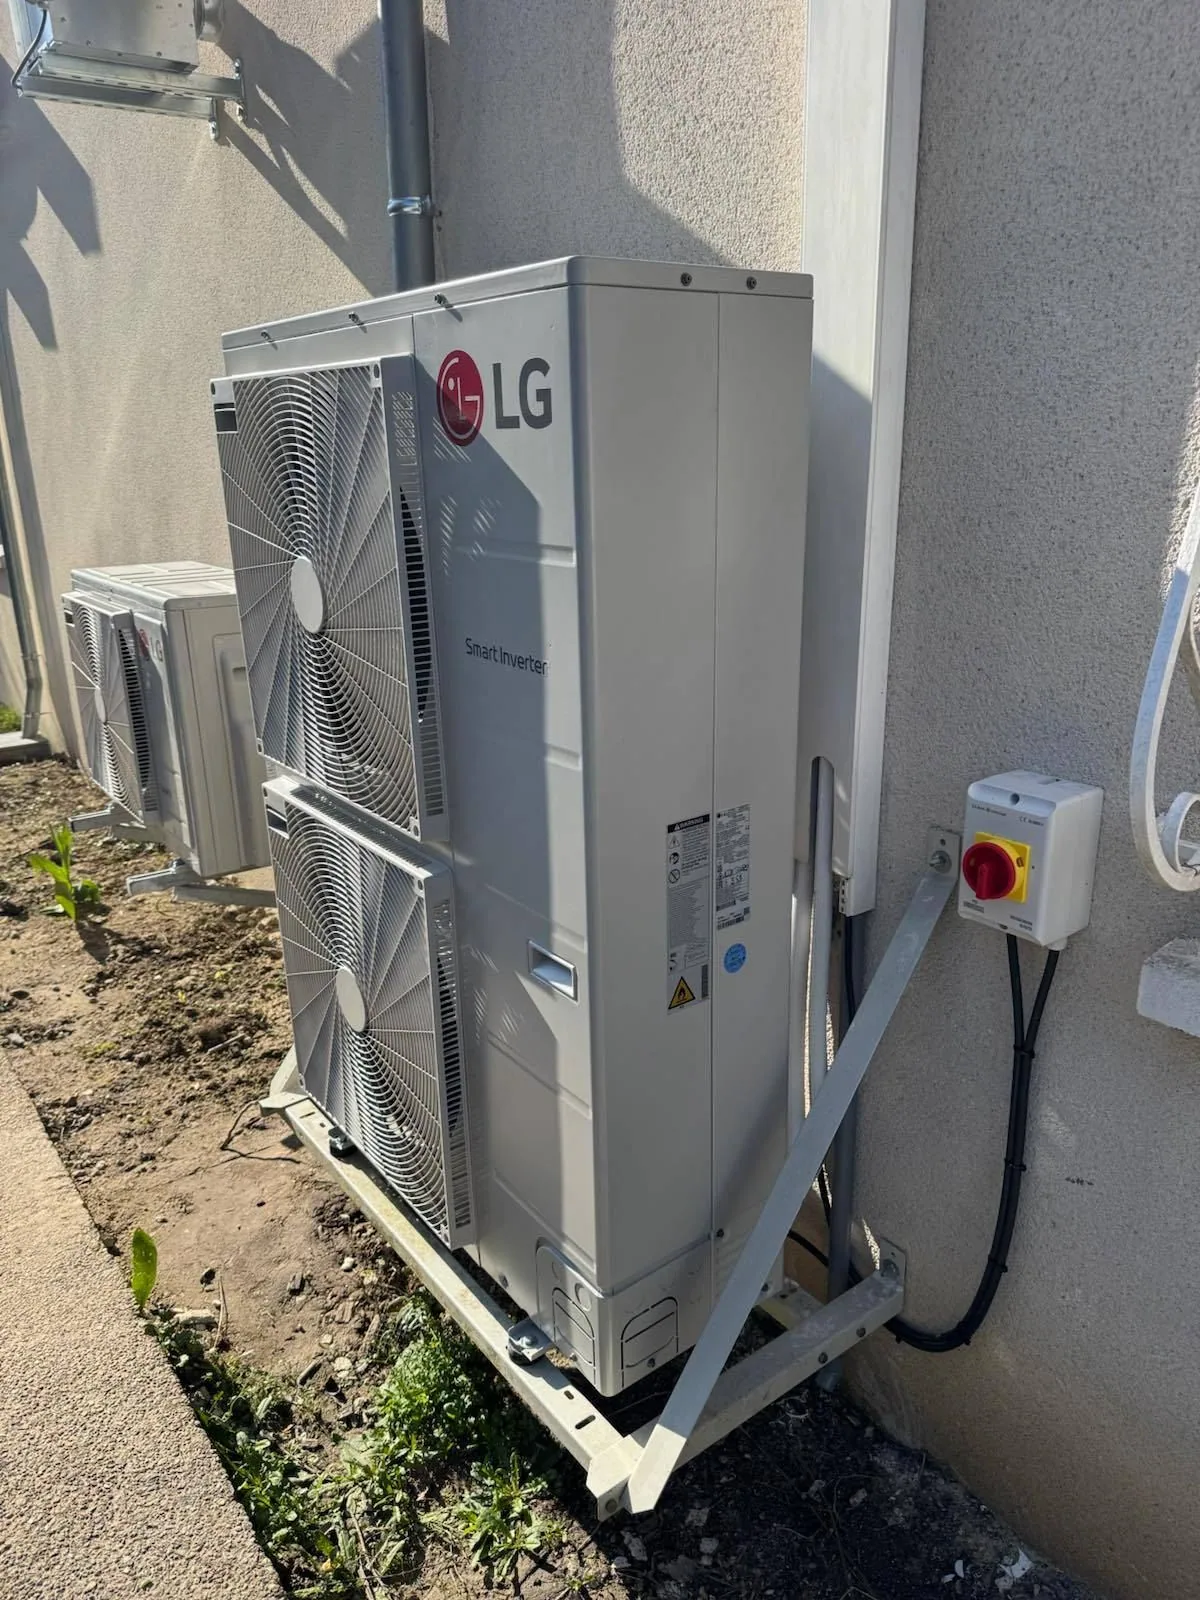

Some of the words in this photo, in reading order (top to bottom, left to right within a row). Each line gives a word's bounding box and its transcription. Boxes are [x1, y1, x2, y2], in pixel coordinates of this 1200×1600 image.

[492, 357, 553, 429] LG
[465, 637, 498, 663] Smart
[500, 646, 547, 675] Inverter
